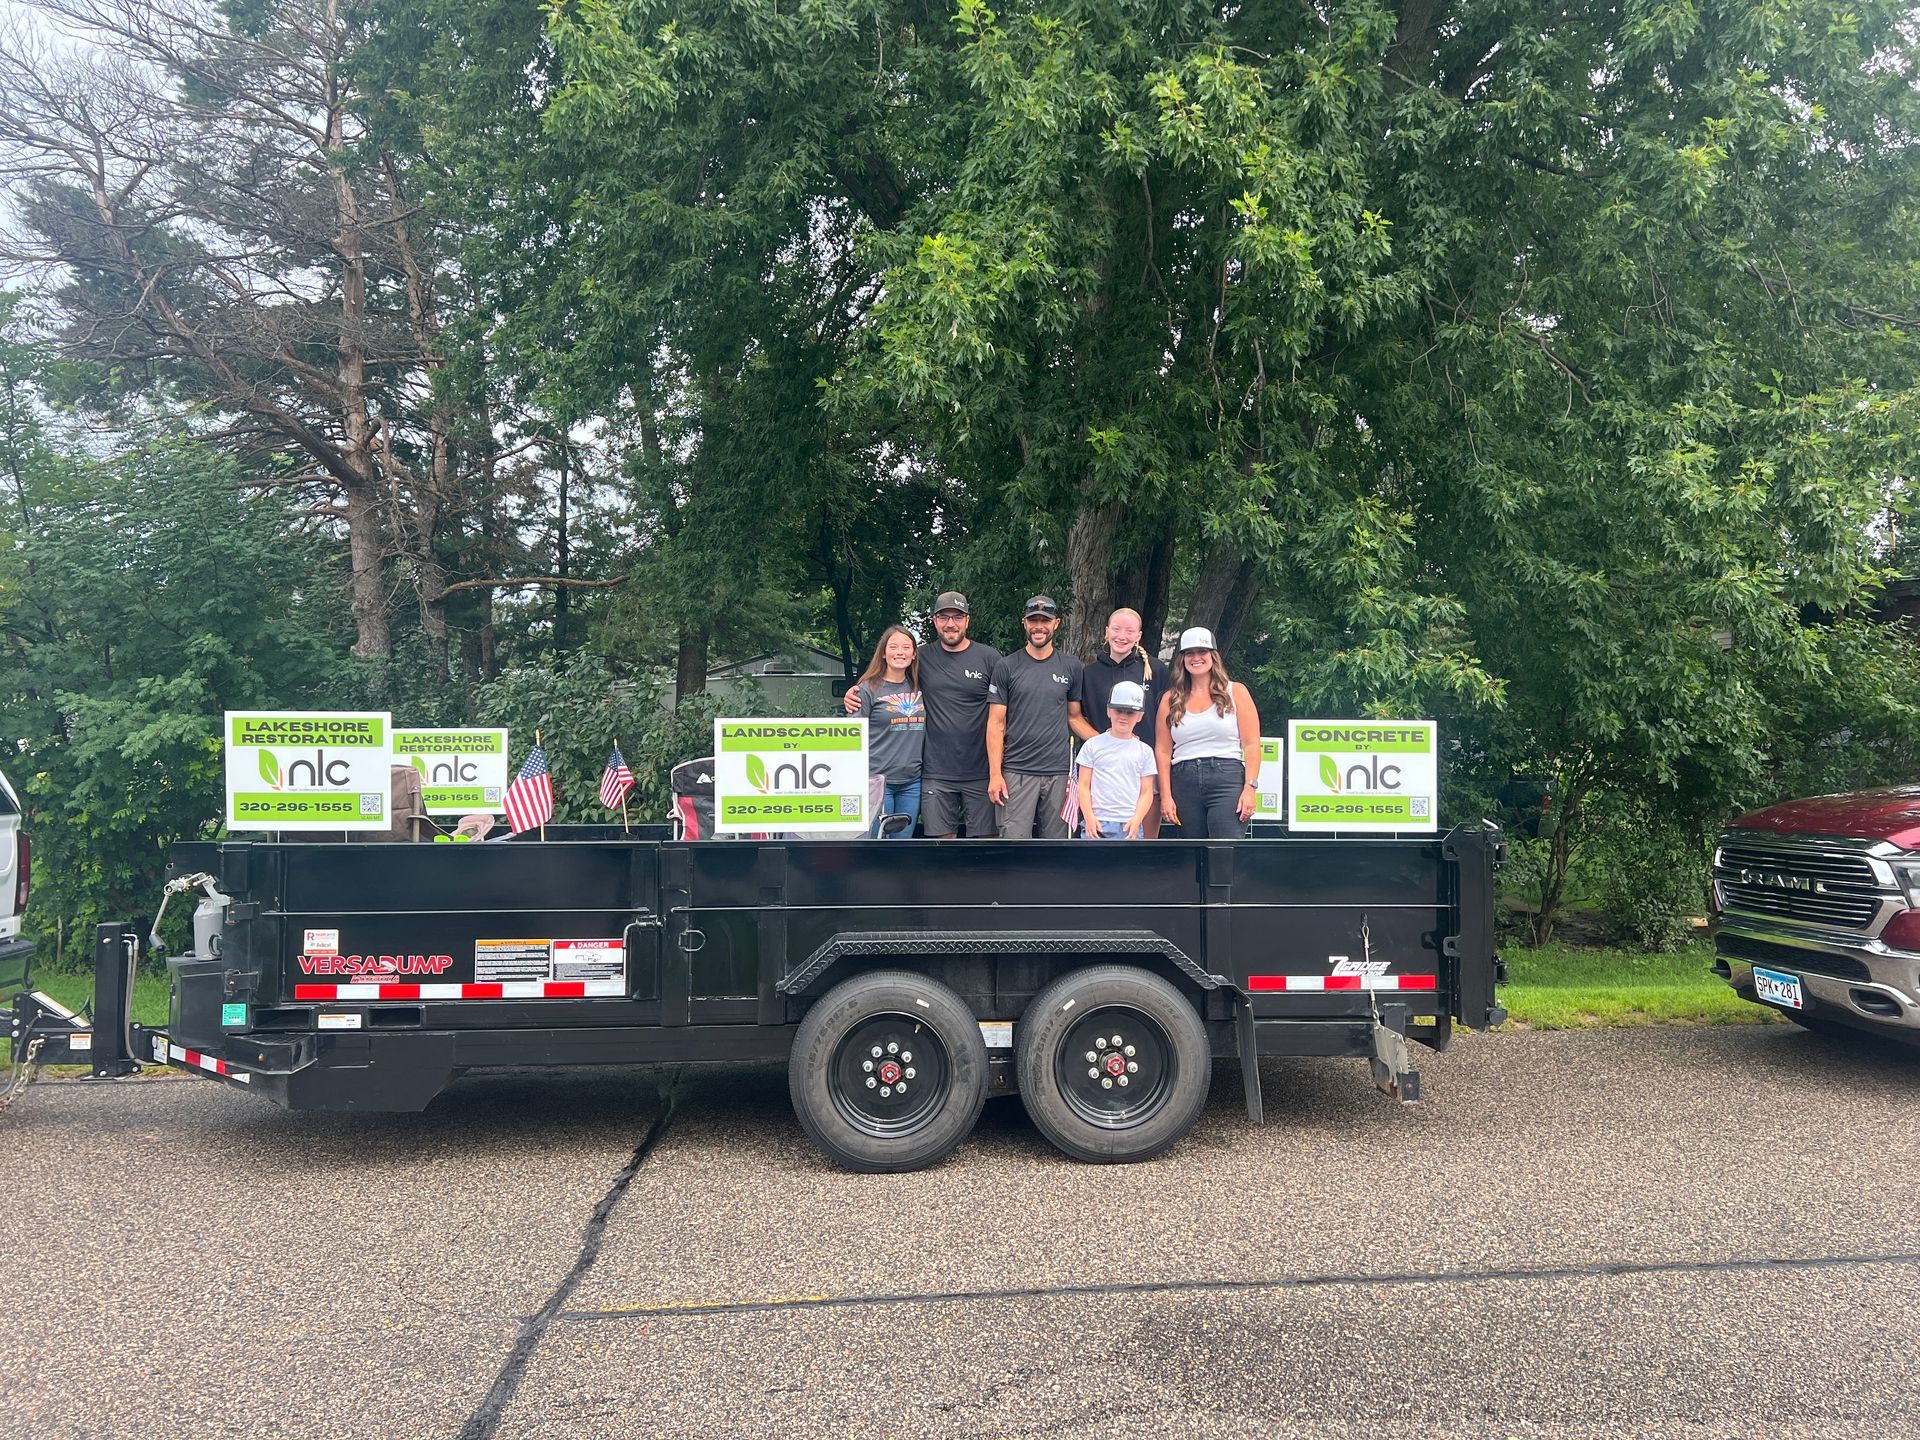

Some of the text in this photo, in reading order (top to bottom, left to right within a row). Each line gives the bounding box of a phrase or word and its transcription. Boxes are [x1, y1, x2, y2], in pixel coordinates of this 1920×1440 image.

[245, 721, 370, 733] LAKESHORE
[722, 727, 861, 738] LANDSCAPING
[241, 734, 374, 745] RESTORATION
[402, 735, 492, 744] LAKESHORE
[1300, 729, 1425, 743] CONCRETE
[399, 744, 495, 752] RESTORATION
[288, 749, 350, 787] nlc
[432, 755, 478, 783] nlc
[774, 753, 832, 790] nlc
[1346, 755, 1402, 790] nlc
[423, 793, 479, 802] 296-1555
[239, 802, 353, 812] 320-296-1555
[727, 804, 834, 814] 320-296-1555
[1301, 805, 1404, 814] 320-296-1555
[577, 941, 610, 949] DANGER
[297, 955, 453, 975] VERSADUMP
[1329, 955, 1391, 977] 7 GAUGE
[1757, 976, 1799, 1001] SPK 281
